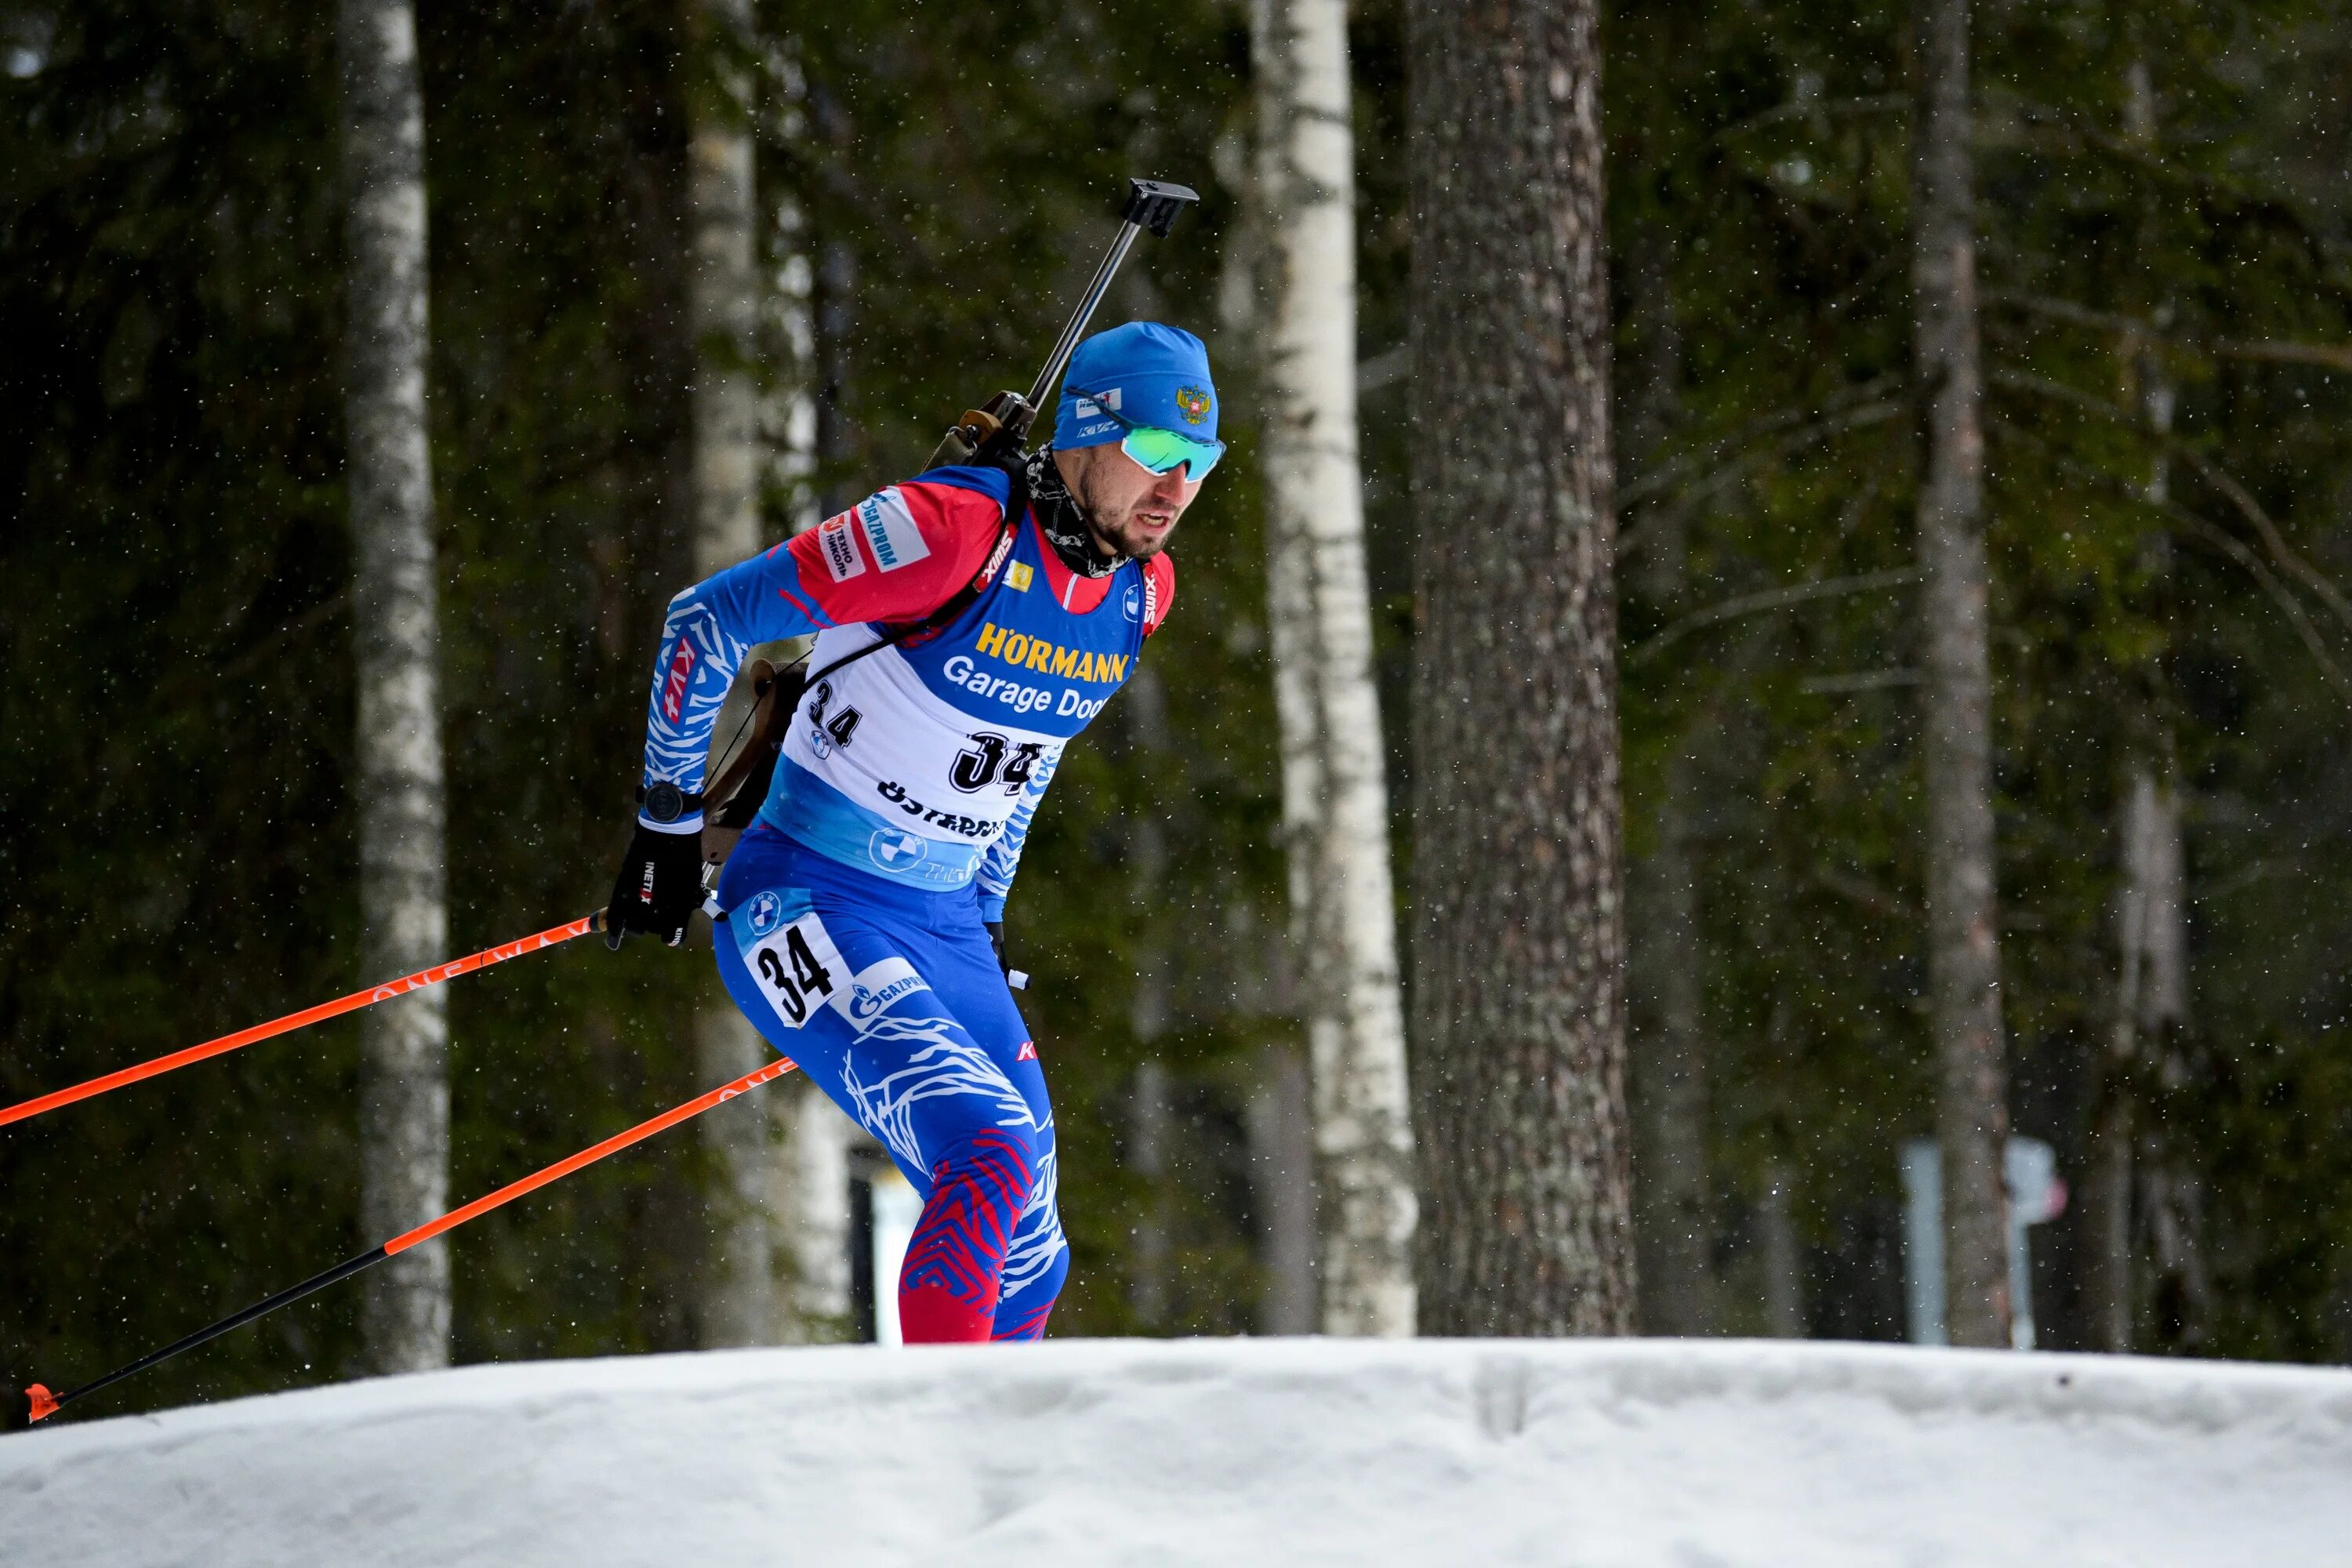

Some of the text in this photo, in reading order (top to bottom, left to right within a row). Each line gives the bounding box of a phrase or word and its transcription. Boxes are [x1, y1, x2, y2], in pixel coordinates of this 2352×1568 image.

[826, 534, 847, 576] НИКОЛЬ
[836, 528, 853, 564] ТЕХНО
[975, 622, 1130, 683] HÖRMANN
[808, 679, 863, 750] 34
[943, 655, 1110, 719] Garage Doo
[949, 731, 1044, 797] 34
[757, 925, 833, 1023] 34
